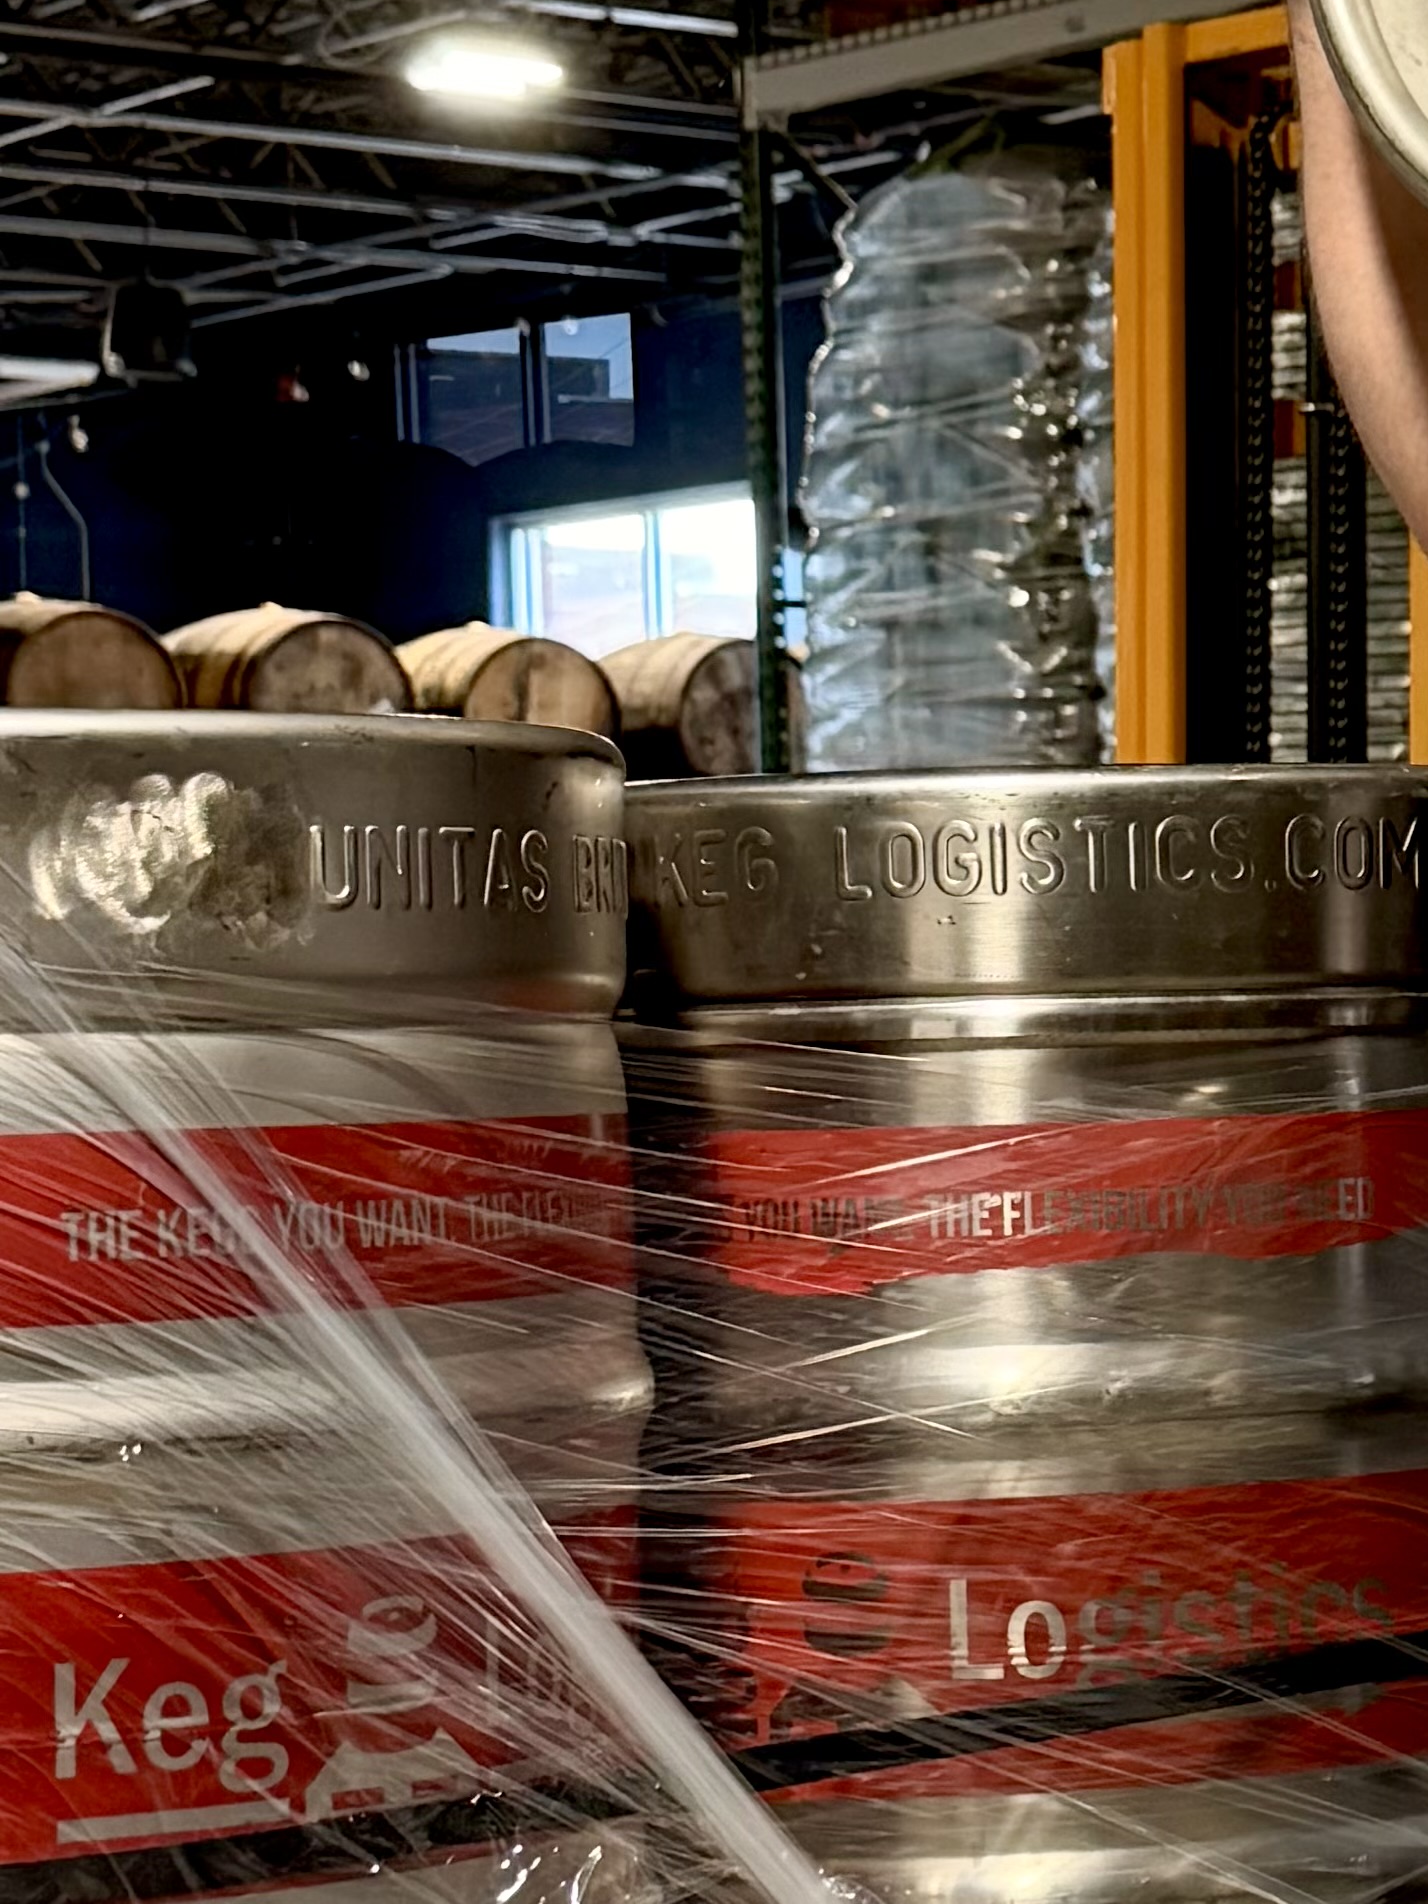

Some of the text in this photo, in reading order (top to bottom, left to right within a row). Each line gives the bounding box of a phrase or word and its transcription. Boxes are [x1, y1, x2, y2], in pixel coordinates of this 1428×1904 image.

[309, 822, 549, 914] UNITAS
[61, 1206, 145, 1263] THE
[273, 1199, 346, 1253] YOU
[928, 1191, 993, 1238] THE
[948, 1560, 1394, 1688] Logistics
[52, 1655, 291, 1794] Keg
